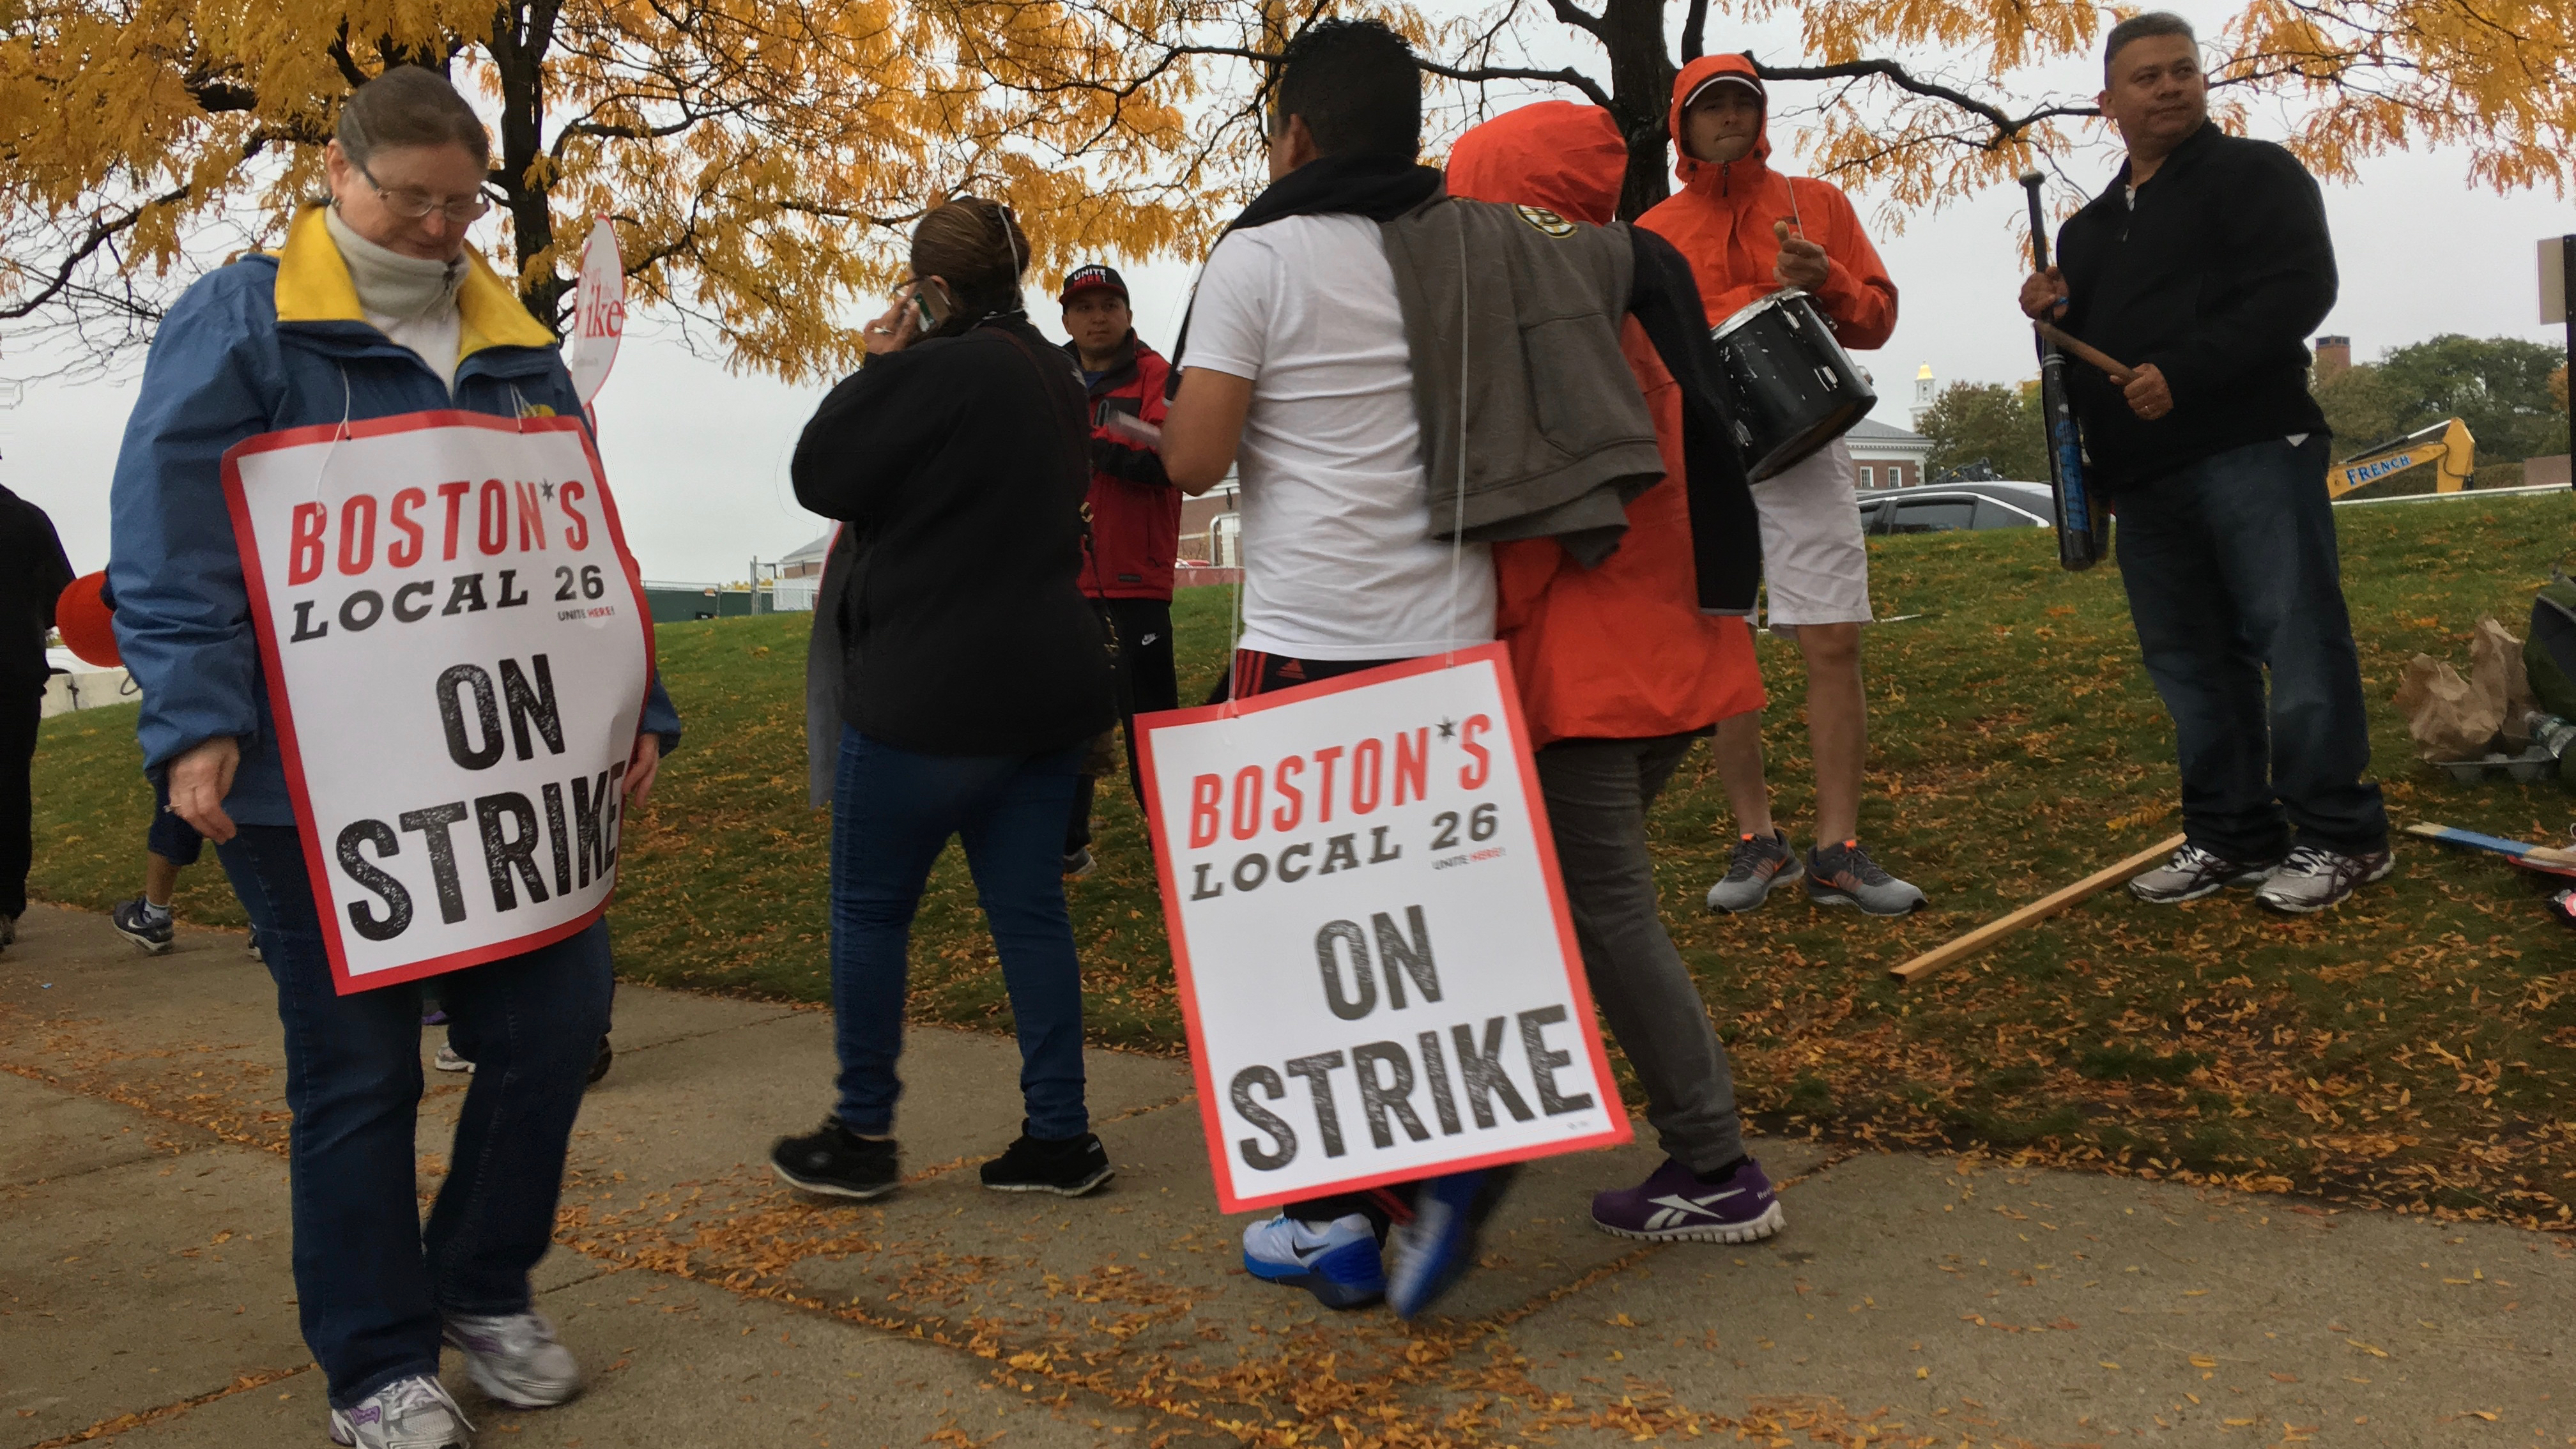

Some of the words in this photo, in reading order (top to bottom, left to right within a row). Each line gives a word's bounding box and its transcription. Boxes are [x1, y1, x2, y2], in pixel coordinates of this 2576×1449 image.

[575, 283, 624, 338] ike
[1074, 268, 1106, 280] UNITE
[2346, 455, 2411, 486] FRENCH
[289, 569, 528, 643] LOCAL
[554, 565, 604, 602] 26
[557, 608, 586, 622] UNITE
[436, 654, 565, 770] ON
[336, 760, 626, 941] STRIKE
[1190, 825, 1402, 901] LOCAL
[1429, 802, 1499, 851] 26
[1314, 904, 1444, 1020] ON
[1228, 1004, 1595, 1171] STRIKE
